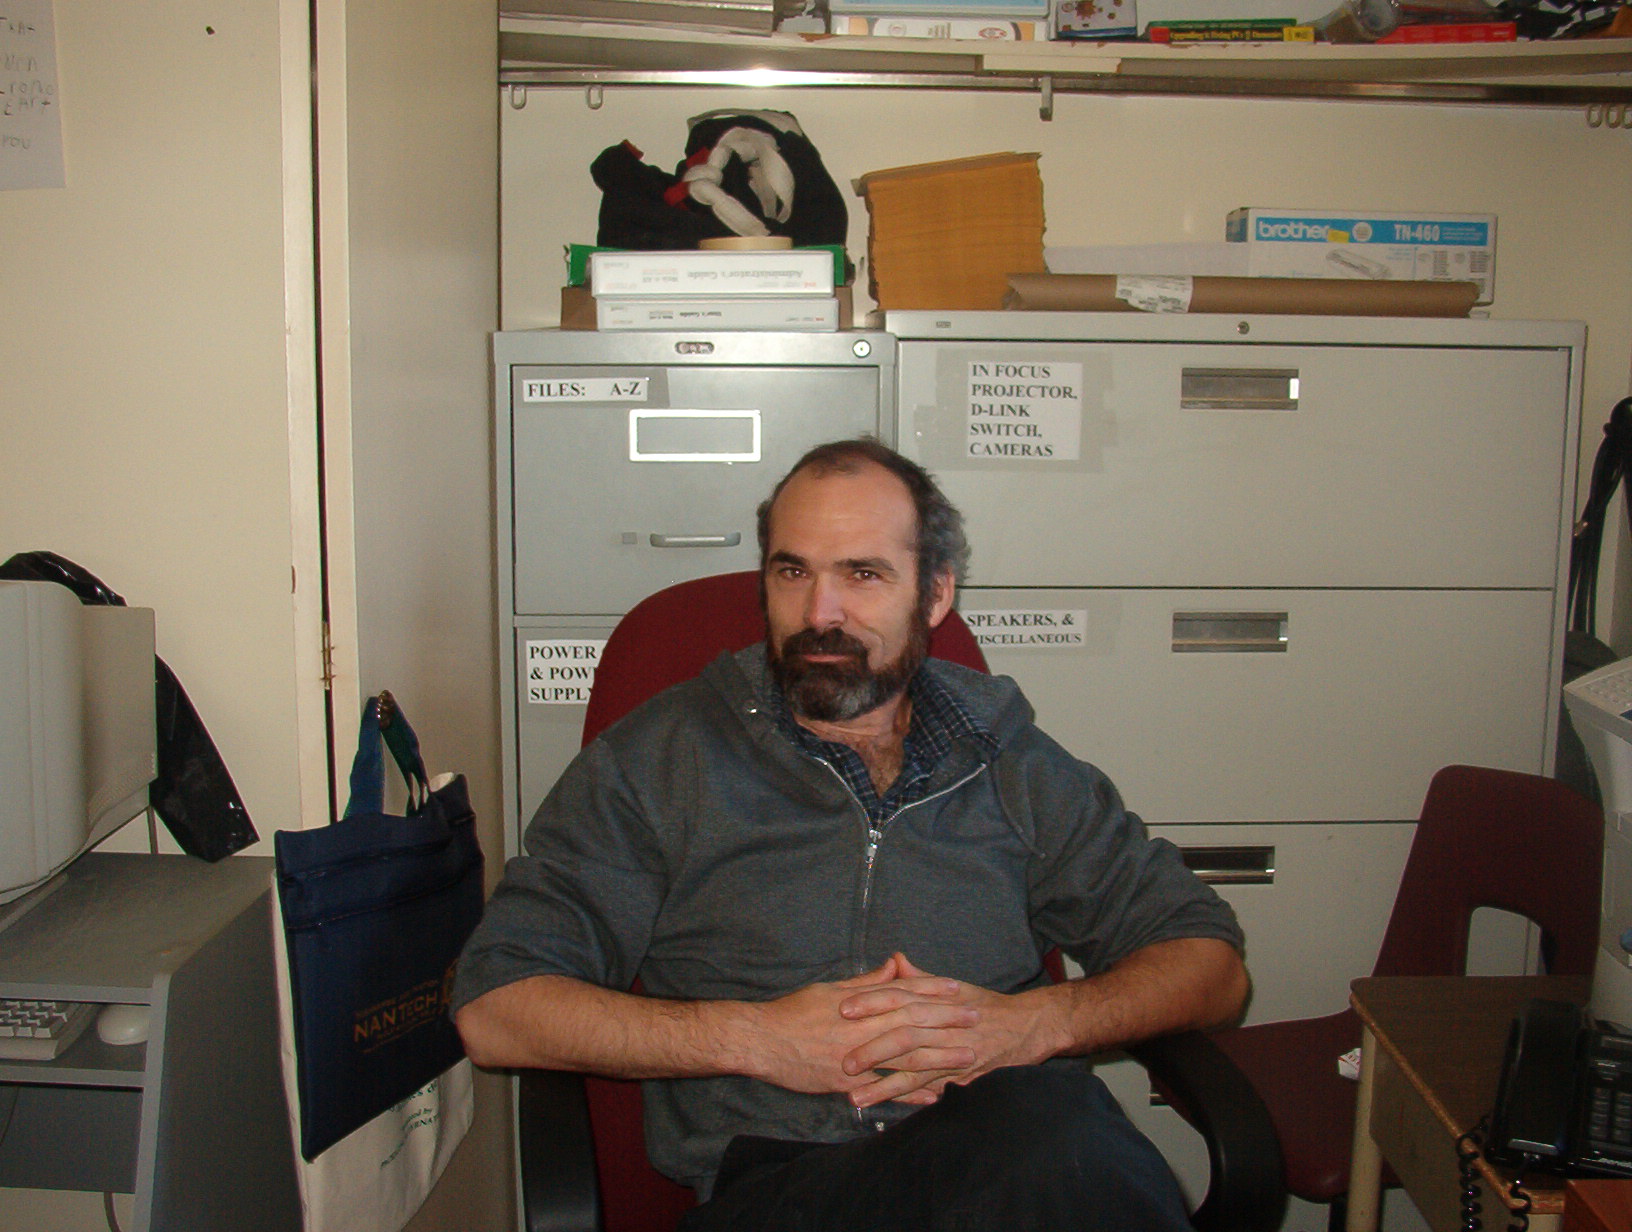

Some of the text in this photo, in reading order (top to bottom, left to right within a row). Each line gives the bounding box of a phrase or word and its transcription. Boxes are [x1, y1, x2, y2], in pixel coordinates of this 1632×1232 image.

[1258, 221, 1330, 239] brother
[1394, 223, 1440, 242] TN-460
[687, 271, 718, 281] Guide
[721, 270, 804, 280] Administrator's
[972, 364, 1051, 379] IN FOCUS
[528, 382, 642, 398] FILES: A-Z
[971, 403, 1031, 418] D-LINK
[969, 441, 1054, 457] CAMERAS
[966, 613, 1074, 627] SPEAKERS, &
[529, 645, 597, 660] POWER
[530, 666, 598, 681] & POW
